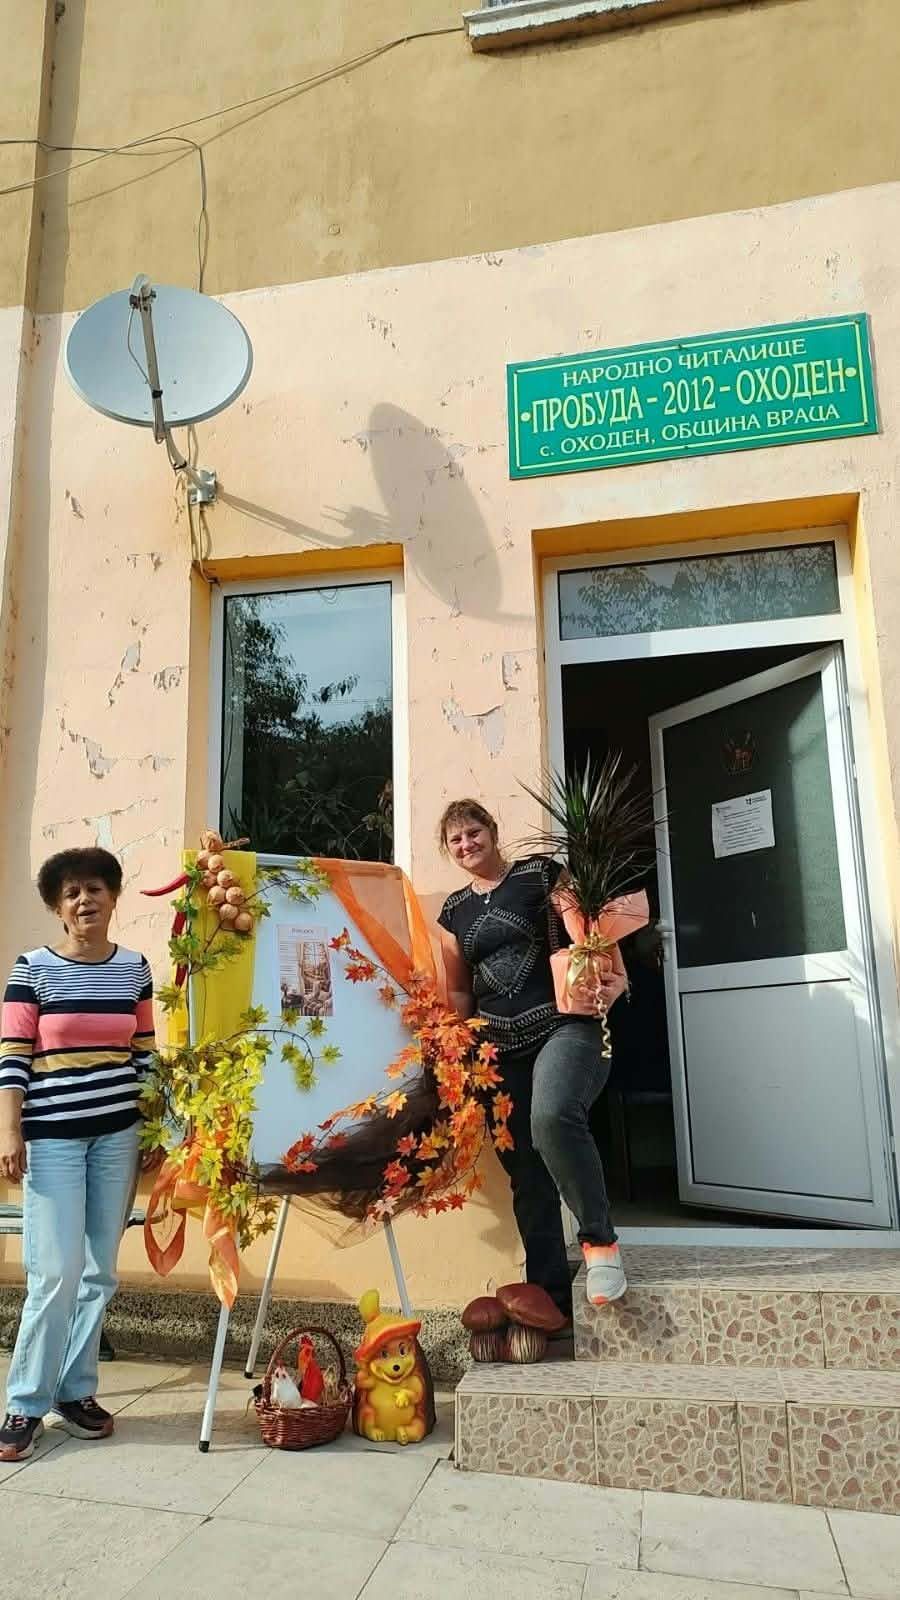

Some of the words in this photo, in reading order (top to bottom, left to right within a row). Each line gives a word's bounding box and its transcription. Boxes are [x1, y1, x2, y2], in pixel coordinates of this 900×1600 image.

[562, 357, 673, 388] НАРОДНО
[679, 338, 807, 370] ЧИТАЛИЩЕ
[532, 386, 643, 433] ПРОБУДА
[663, 375, 716, 415] 2012
[736, 358, 846, 405] ОХОДЕН
[560, 428, 656, 455] ОХОДЕН,
[662, 415, 761, 441] ОБЩИНА
[767, 404, 840, 427] ВРАЦА
